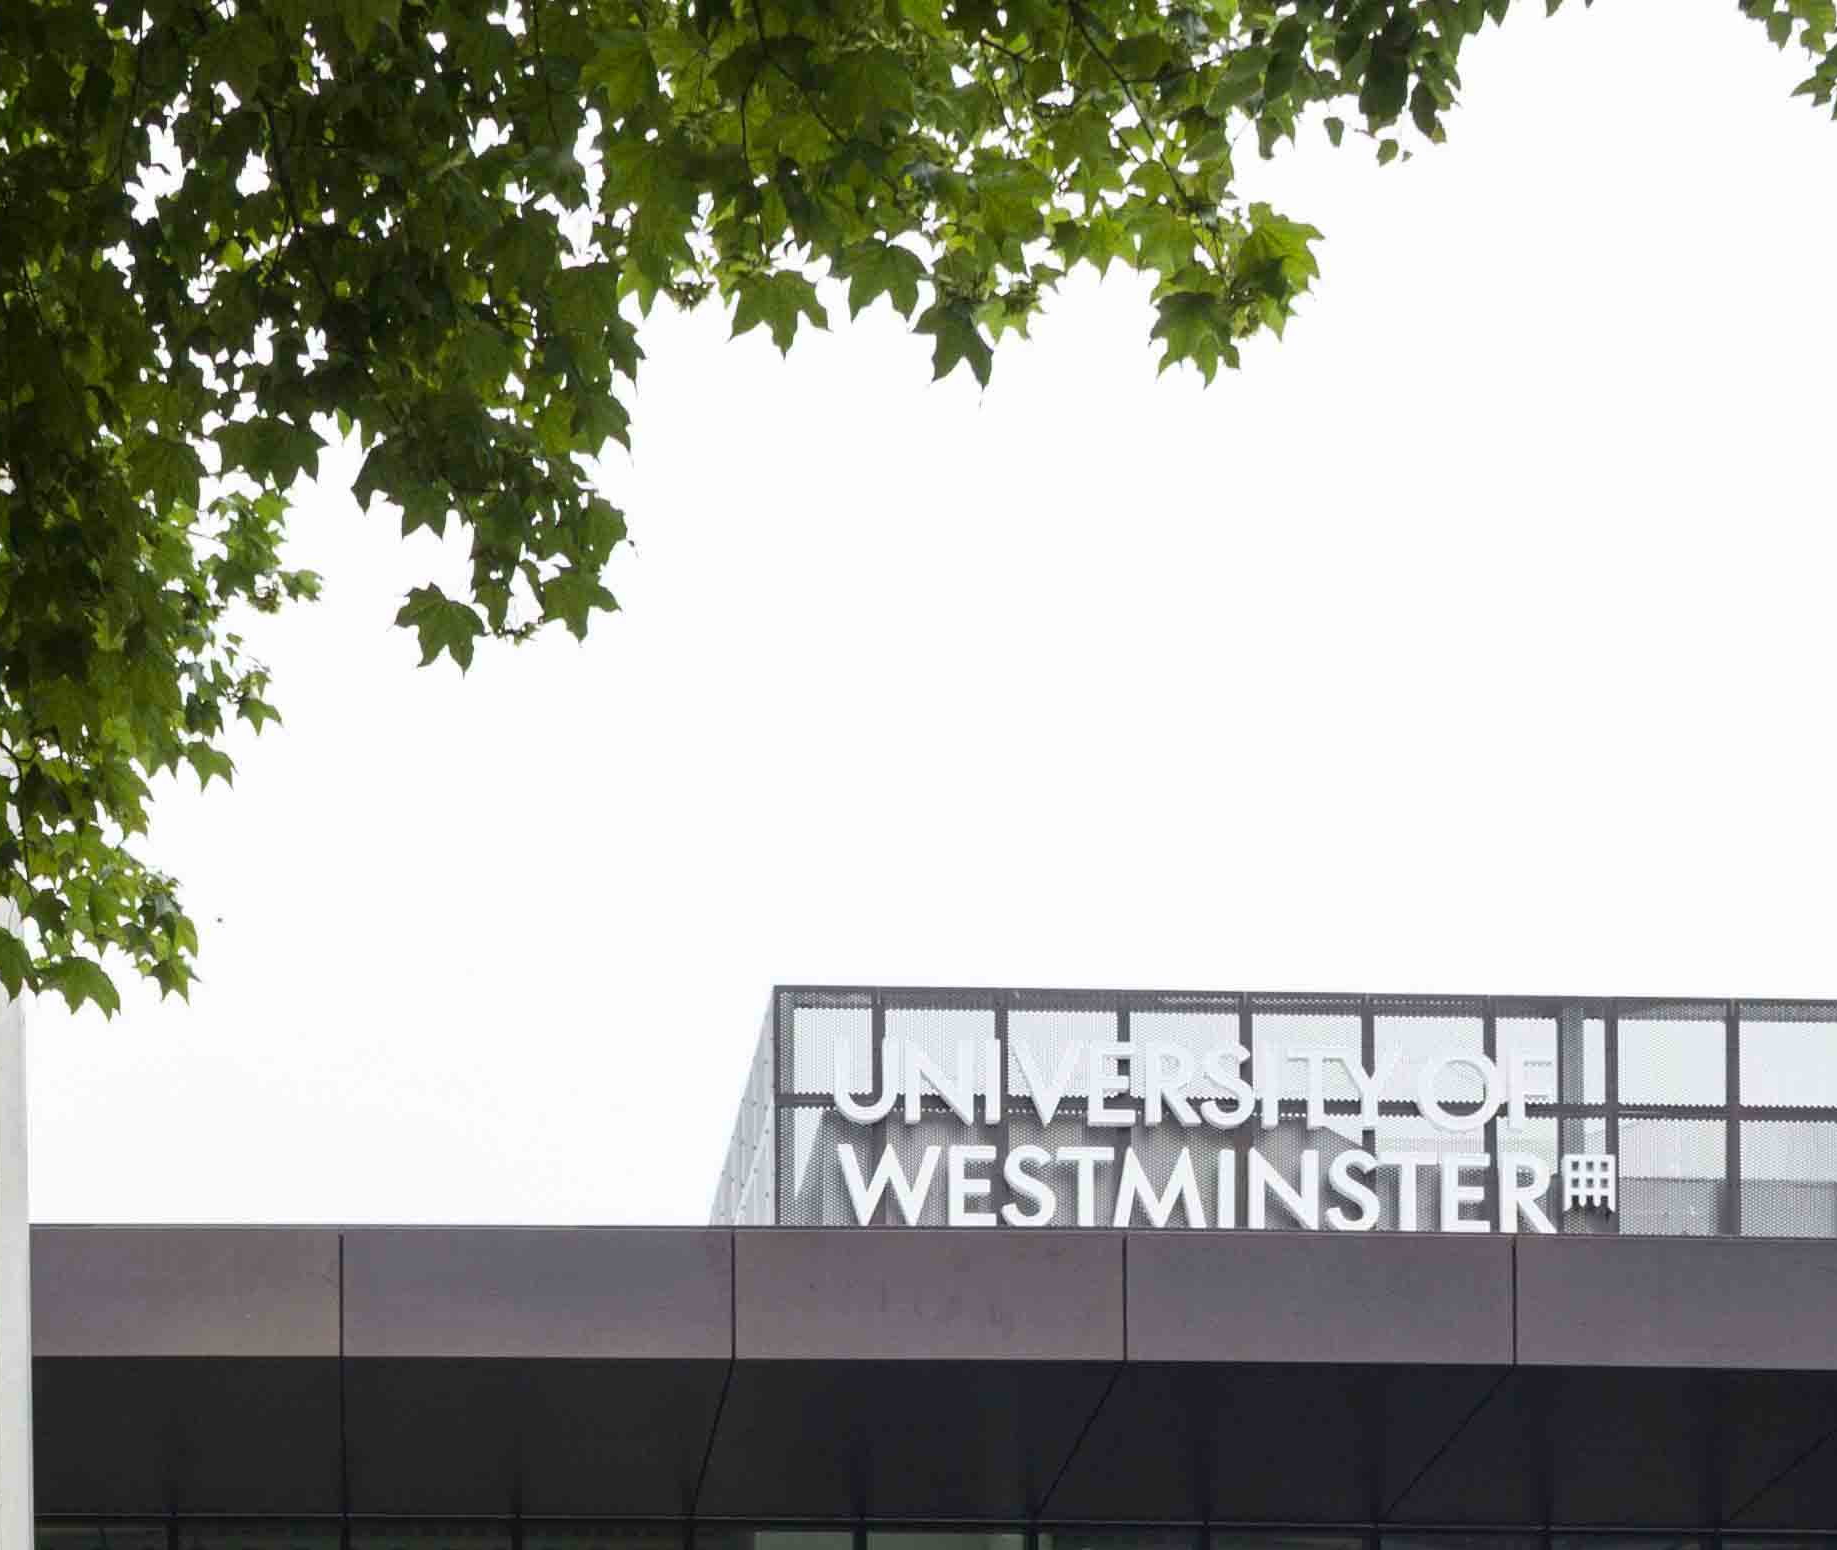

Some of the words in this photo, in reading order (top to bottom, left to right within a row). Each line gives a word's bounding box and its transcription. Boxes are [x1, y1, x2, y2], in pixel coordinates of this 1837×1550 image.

[833, 1037, 1403, 1130] UNIVERSITY
[1416, 1048, 1555, 1134] OF
[836, 1143, 1558, 1233] WESTMINSTER
